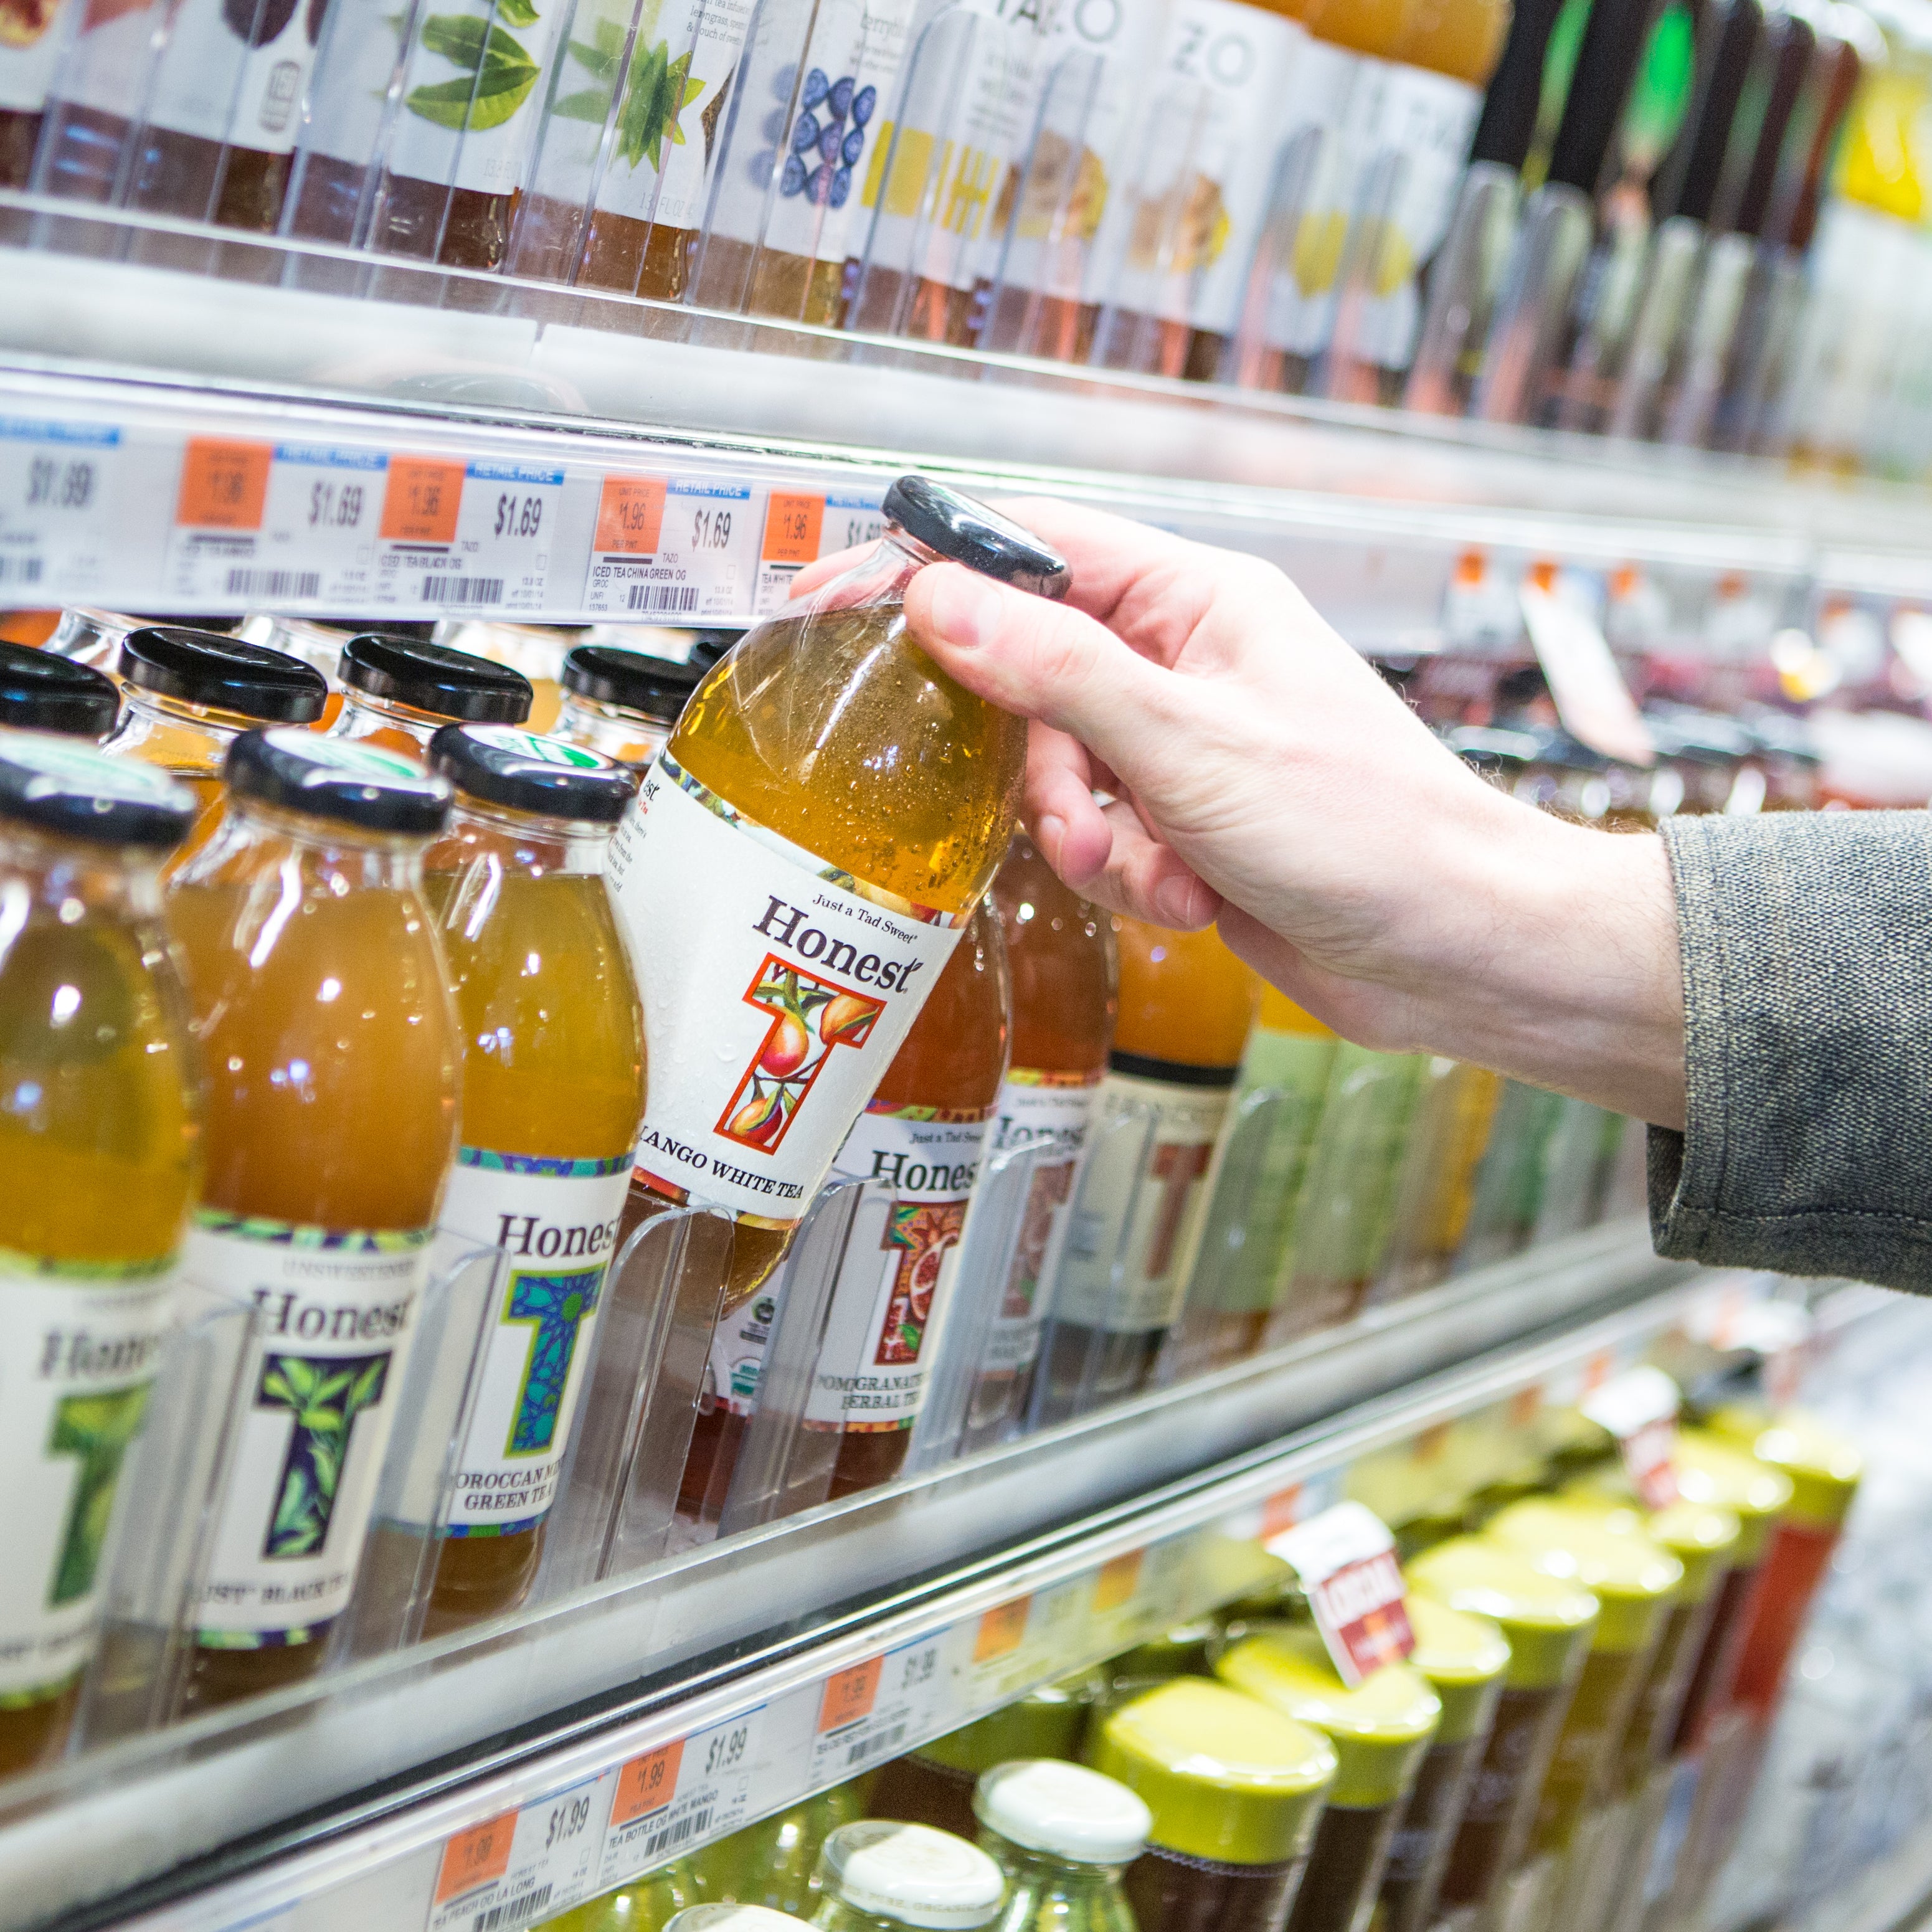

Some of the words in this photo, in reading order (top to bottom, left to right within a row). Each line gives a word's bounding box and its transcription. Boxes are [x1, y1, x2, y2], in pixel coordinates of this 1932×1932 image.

[675, 480, 711, 495] RETAIL
[712, 483, 742, 497] PRICE
[495, 493, 542, 539] $1.69
[692, 507, 732, 552] $1.69
[592, 566, 611, 578] ICED
[613, 566, 626, 578] TEA
[627, 567, 649, 579] CHINA
[649, 567, 673, 580] GREEN
[675, 569, 686, 580] OG
[662, 552, 678, 564] TAZO
[592, 579, 609, 589] GROC
[812, 894, 844, 912] Just
[845, 907, 854, 917] a
[856, 908, 883, 928] Tad
[881, 920, 918, 944] Sweet
[752, 894, 924, 995] Honest
[711, 1159, 777, 1195] WHITE
[775, 1181, 805, 1200] TEA
[871, 1149, 980, 1191] Hones
[498, 1213, 622, 1258] Hones
[457, 1467, 544, 1490] OROCCAN
[463, 1490, 529, 1511] GREEN
[705, 1726, 747, 1775] $1.99
[545, 1796, 590, 1854] $1.99
[608, 1836, 623, 1850] TEA
[625, 1820, 654, 1844] BOTTLE
[510, 1875, 536, 1897] LONG
